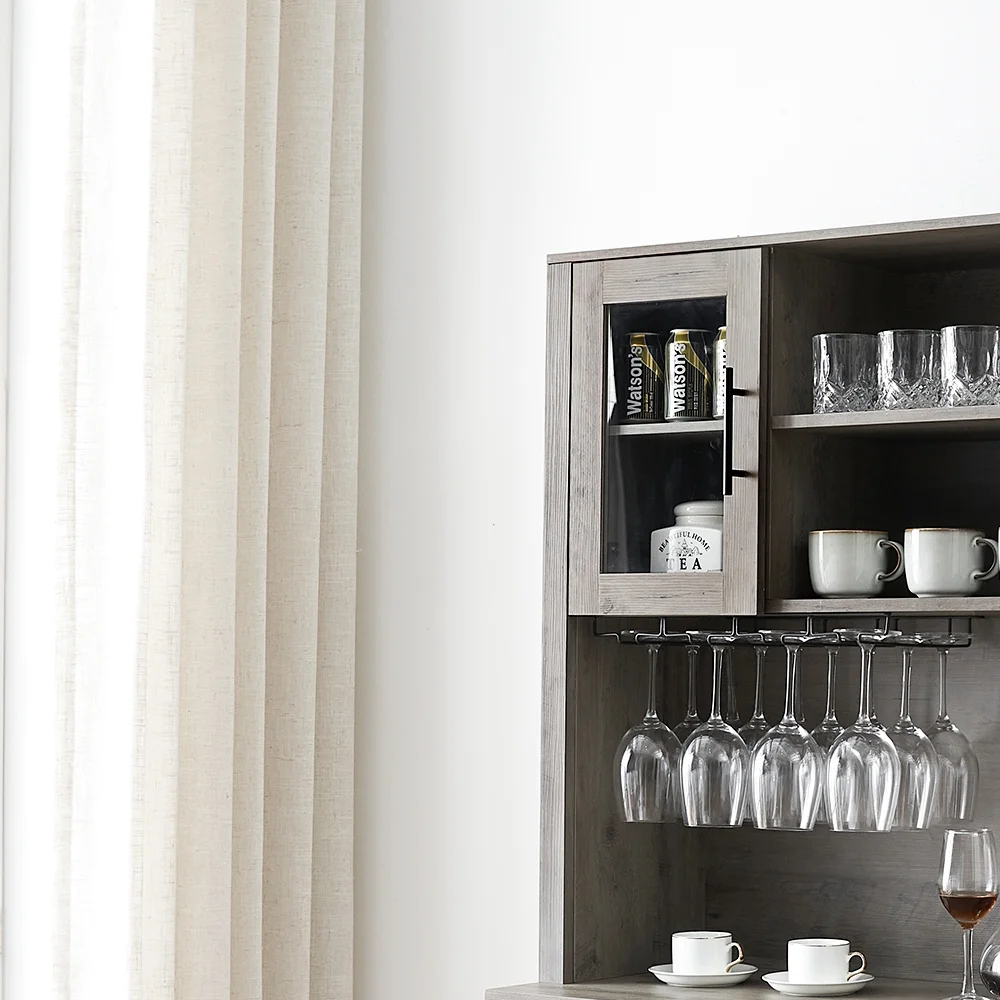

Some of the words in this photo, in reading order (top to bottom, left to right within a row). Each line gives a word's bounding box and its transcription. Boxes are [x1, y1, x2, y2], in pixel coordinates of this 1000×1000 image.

[626, 346, 643, 416] Watson's
[673, 342, 687, 413] Watson's
[658, 531, 693, 553] BEAIFUL
[691, 532, 712, 552] HOME
